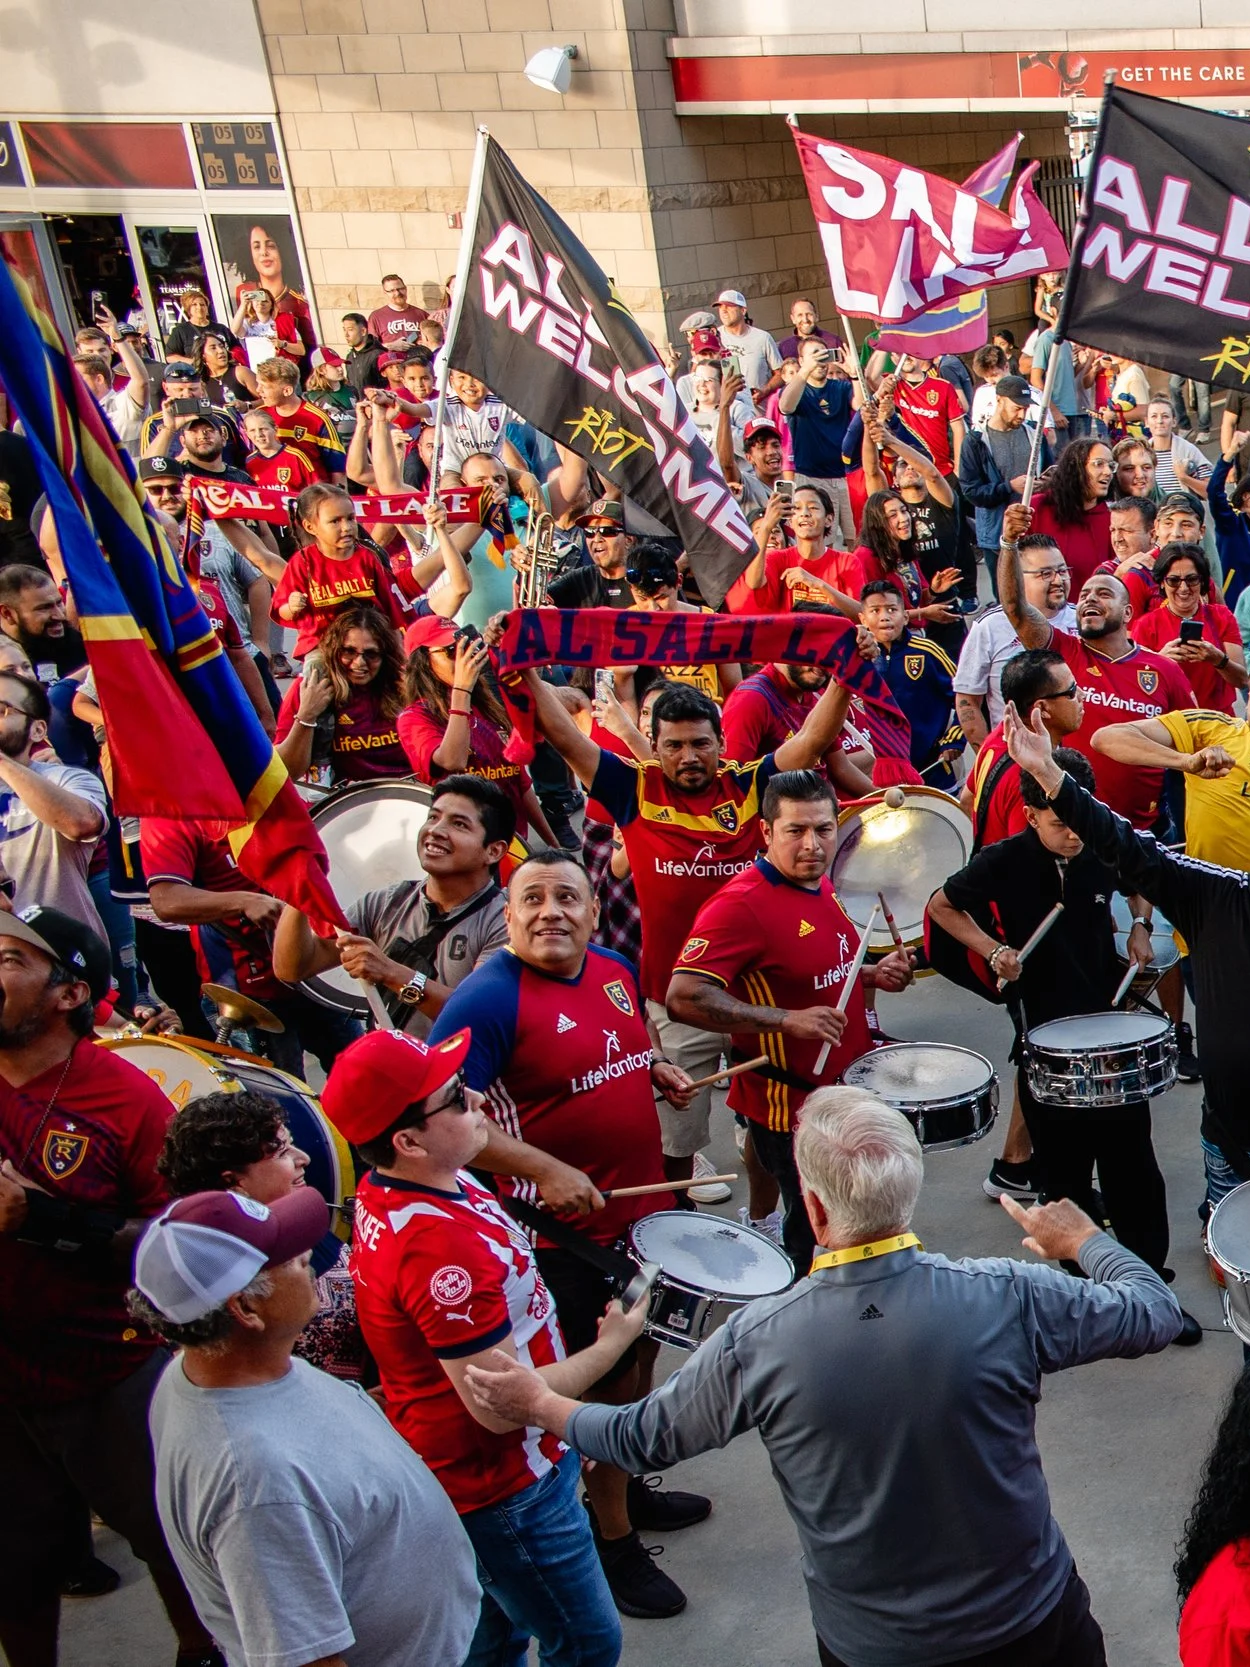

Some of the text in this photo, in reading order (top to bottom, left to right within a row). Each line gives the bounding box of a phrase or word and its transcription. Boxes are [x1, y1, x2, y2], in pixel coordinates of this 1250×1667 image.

[1121, 67, 1155, 82] GET
[1159, 67, 1193, 82] THE
[1200, 66, 1246, 82] CARE
[214, 125, 232, 139] 05
[245, 125, 262, 139] 05
[207, 164, 224, 179] 05
[239, 164, 256, 179] 05
[159, 286, 178, 294] TEAM
[387, 318, 420, 335] Hurley
[564, 406, 655, 472] RIOT
[379, 493, 470, 518] LAE
[309, 583, 334, 603] REAL
[334, 578, 360, 595] SALT
[511, 608, 593, 664] AL
[664, 665, 704, 677] AZZ
[1082, 686, 1163, 719] feVantage
[333, 730, 400, 752] LifeVant
[655, 857, 753, 877] LifeVantage
[814, 960, 855, 990] LifeVa
